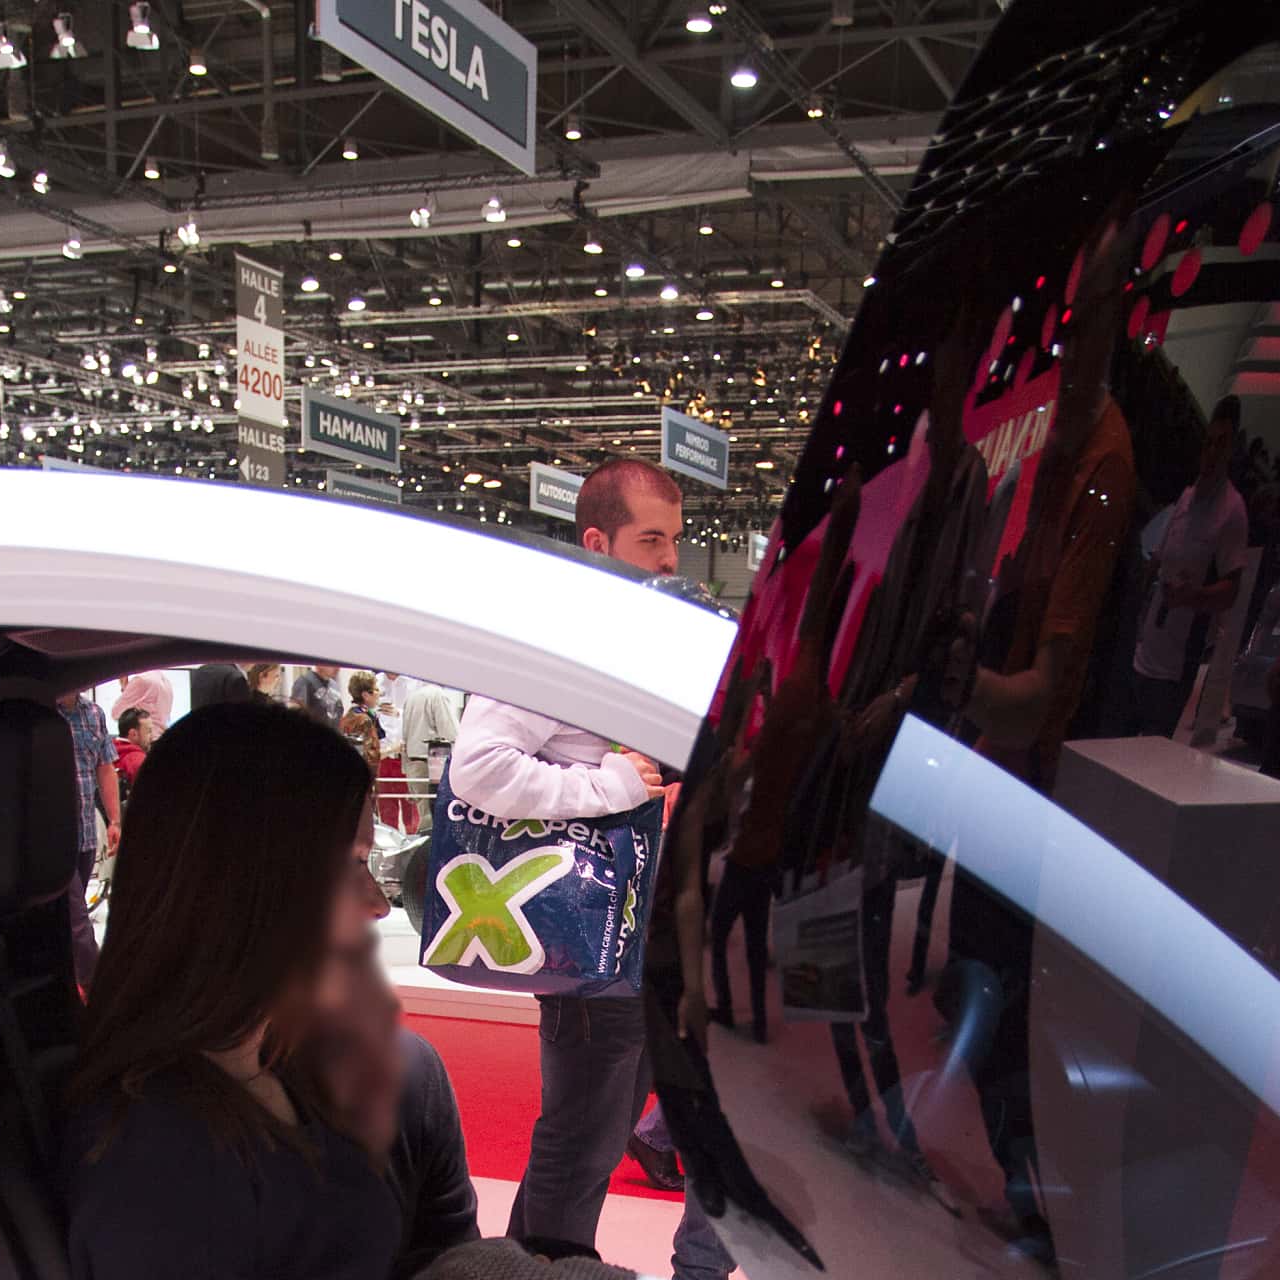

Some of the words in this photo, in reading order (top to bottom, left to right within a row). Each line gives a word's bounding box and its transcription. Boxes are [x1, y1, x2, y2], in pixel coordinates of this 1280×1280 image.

[394, 0, 489, 101] TESLA
[240, 267, 280, 298] HALLE
[253, 294, 267, 325] 4
[239, 364, 283, 401] 4200
[237, 425, 286, 454] HALLES
[319, 411, 388, 453] HAMANN
[597, 888, 618, 974] www.carxpert.ch
